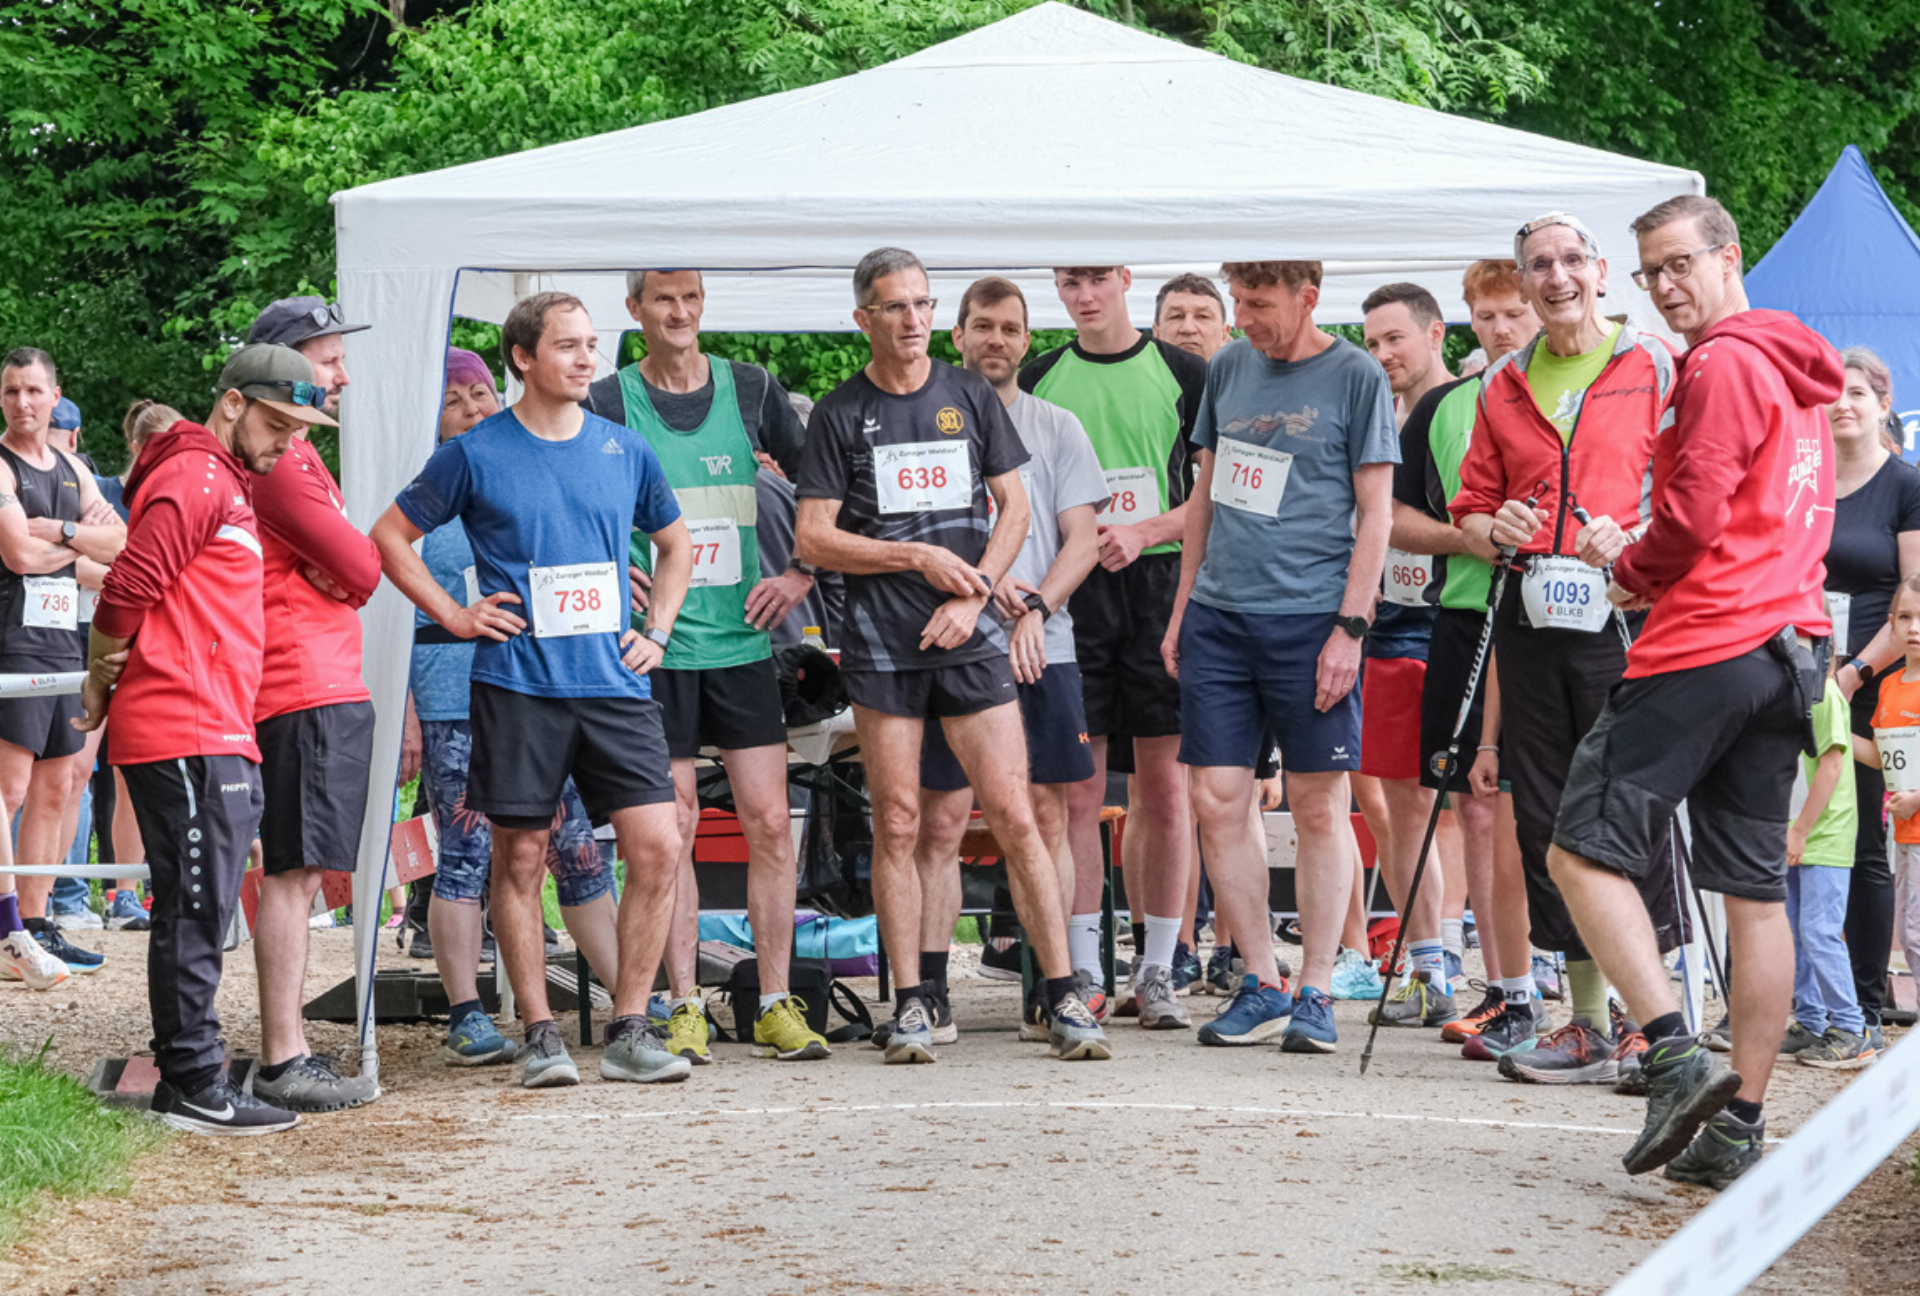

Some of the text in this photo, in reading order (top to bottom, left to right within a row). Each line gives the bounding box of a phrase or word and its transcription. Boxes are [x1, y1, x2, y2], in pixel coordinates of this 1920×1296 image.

[898, 466, 947, 490] 638
[1231, 462, 1264, 490] 716
[1096, 491, 1137, 514] 78
[692, 543, 720, 566] 77
[1392, 564, 1427, 587] 669
[41, 593, 69, 613] 736
[554, 588, 602, 613] 738
[1542, 580, 1591, 605] 1093
[1556, 605, 1584, 618] BLKB
[1881, 749, 1906, 771] 26
